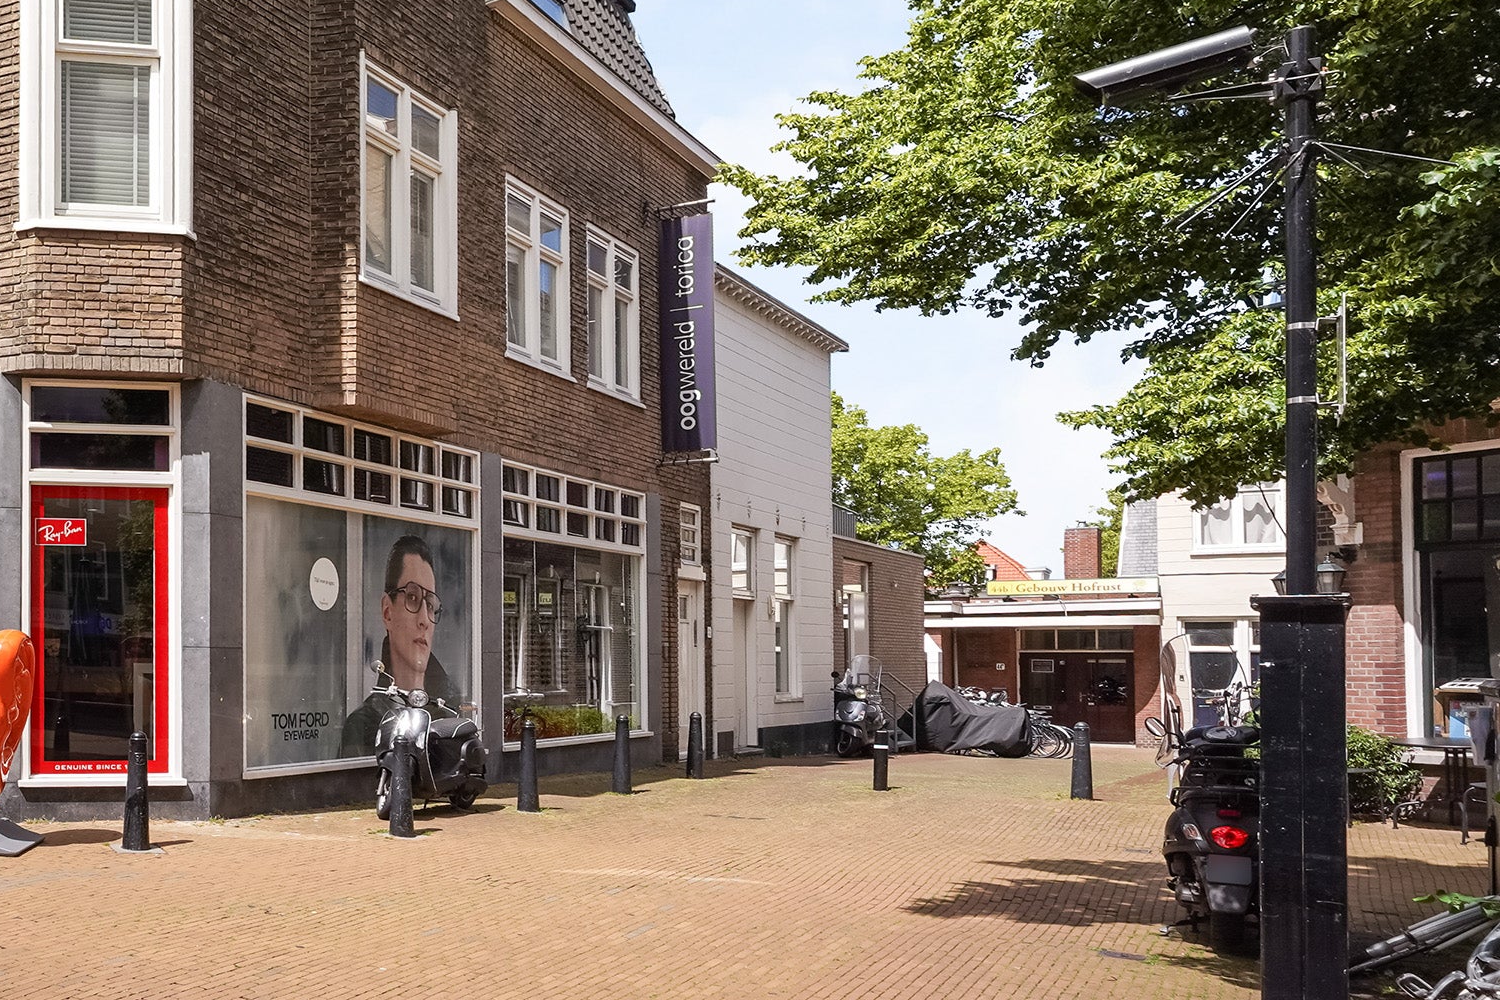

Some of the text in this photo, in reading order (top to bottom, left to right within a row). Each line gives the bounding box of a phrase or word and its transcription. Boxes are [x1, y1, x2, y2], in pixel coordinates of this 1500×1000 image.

[672, 236, 701, 431] oogwereld torica
[37, 520, 83, 543] Ray-Ban
[1015, 583, 1068, 593] Gebouw
[1071, 581, 1122, 592] Hofrust
[271, 711, 330, 730] TOM FORD
[283, 729, 320, 741] EYEWEAR
[54, 763, 94, 771] GENUINE
[96, 763, 122, 771] SINCE
